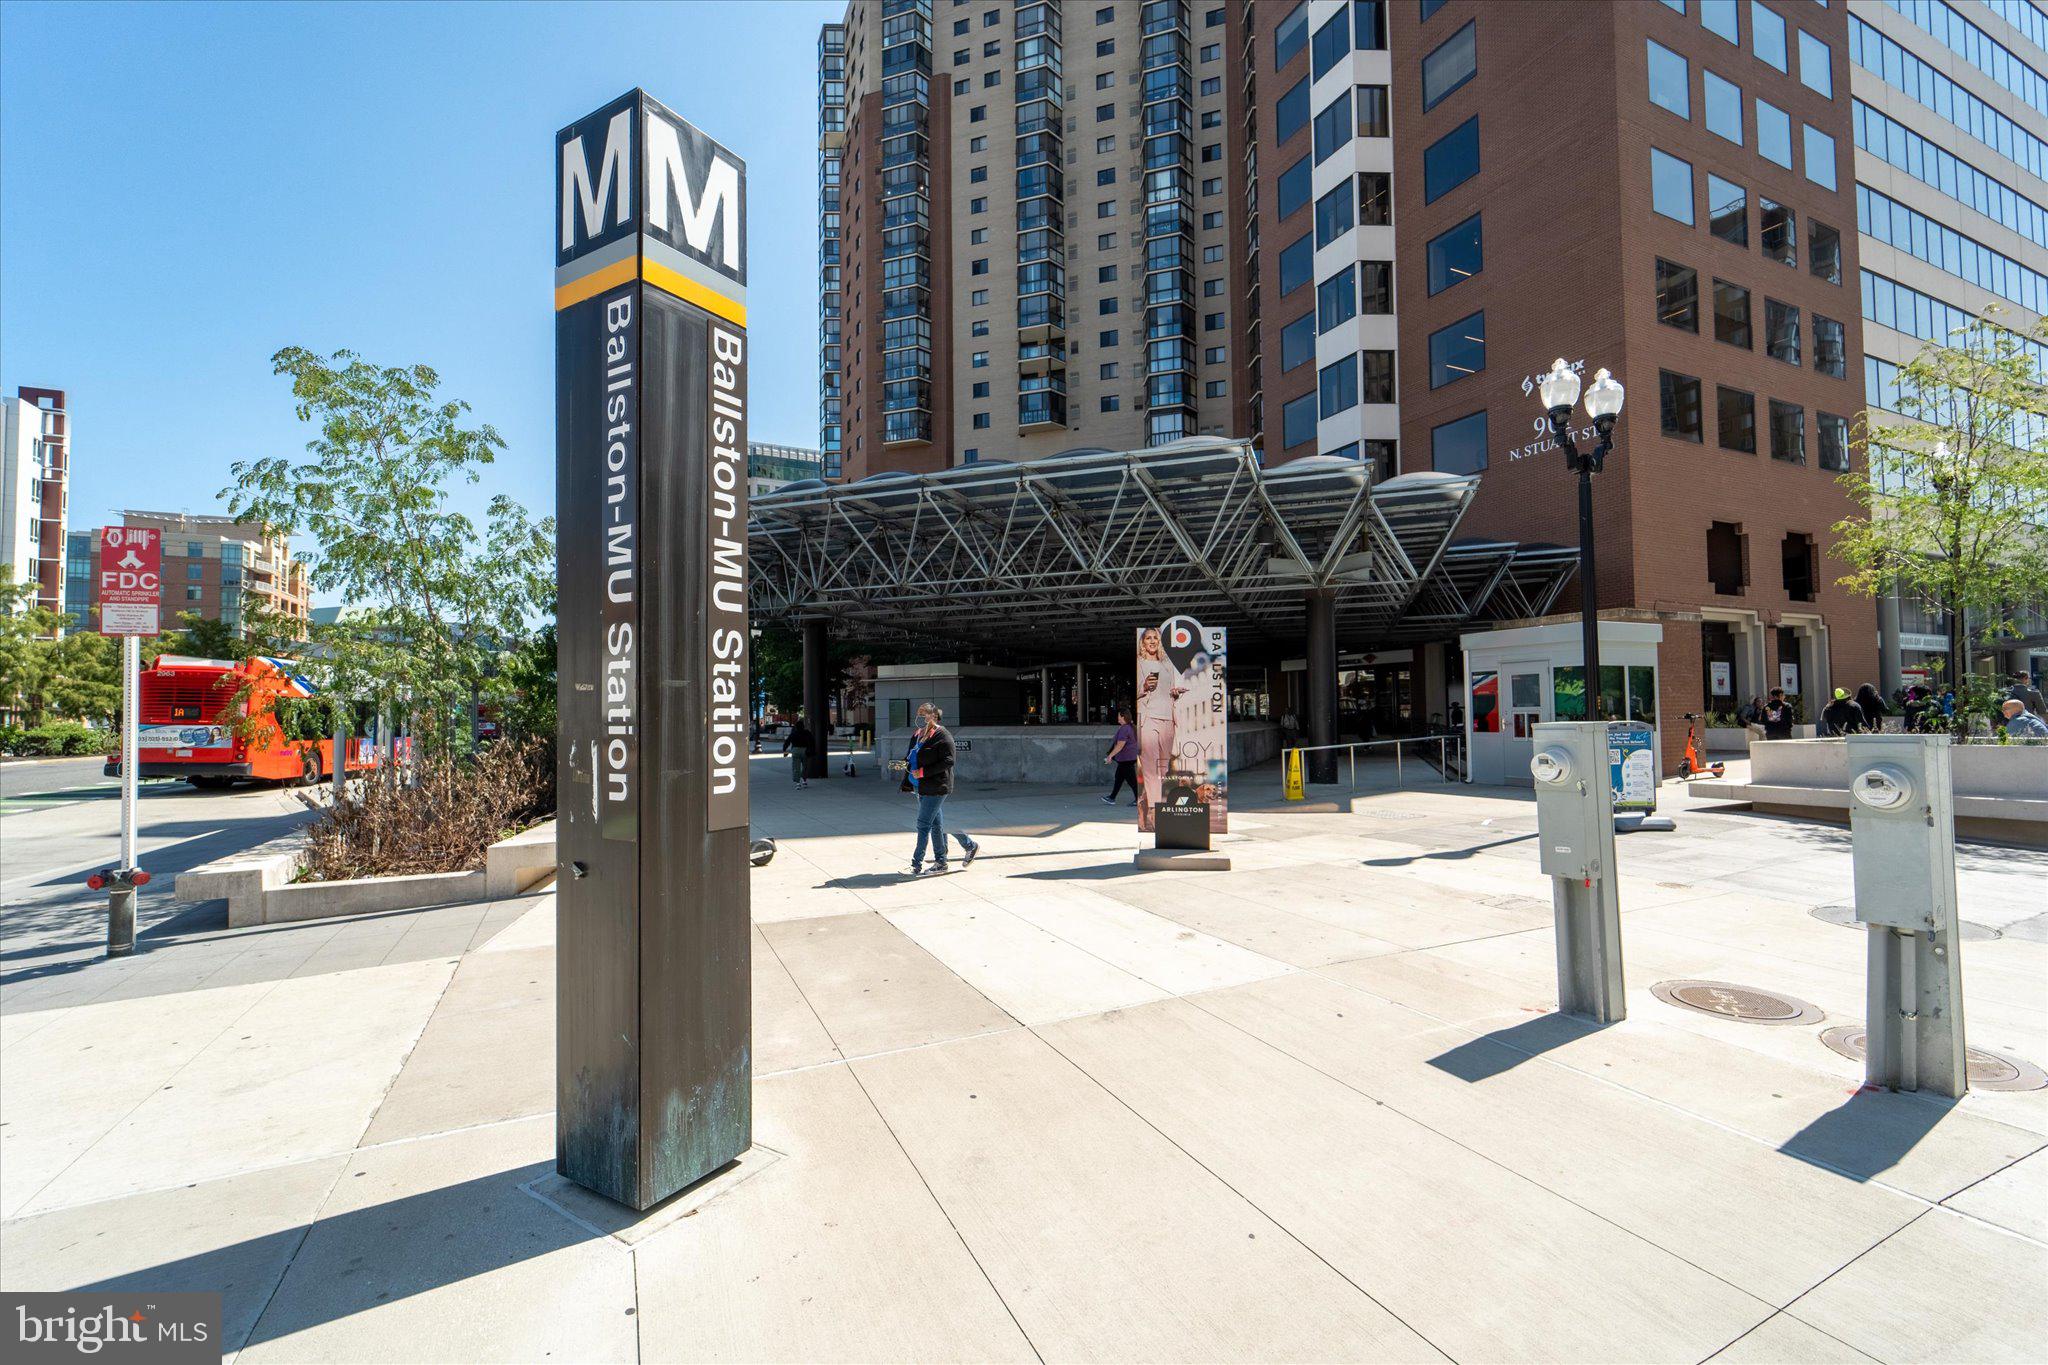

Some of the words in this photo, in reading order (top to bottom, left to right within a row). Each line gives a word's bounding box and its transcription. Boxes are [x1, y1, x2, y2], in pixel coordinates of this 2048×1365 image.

[562, 107, 633, 252] M
[647, 112, 739, 272] M
[606, 294, 633, 604] Ballston-MU
[712, 326, 744, 614] Ballston-MU
[1509, 448, 1522, 461] N.
[1524, 431, 1579, 457] STUAT
[102, 571, 158, 590] FDC
[174, 708, 185, 717] 1A
[606, 621, 633, 802] Station
[712, 628, 744, 795] Station
[1170, 741, 1212, 759] JOY
